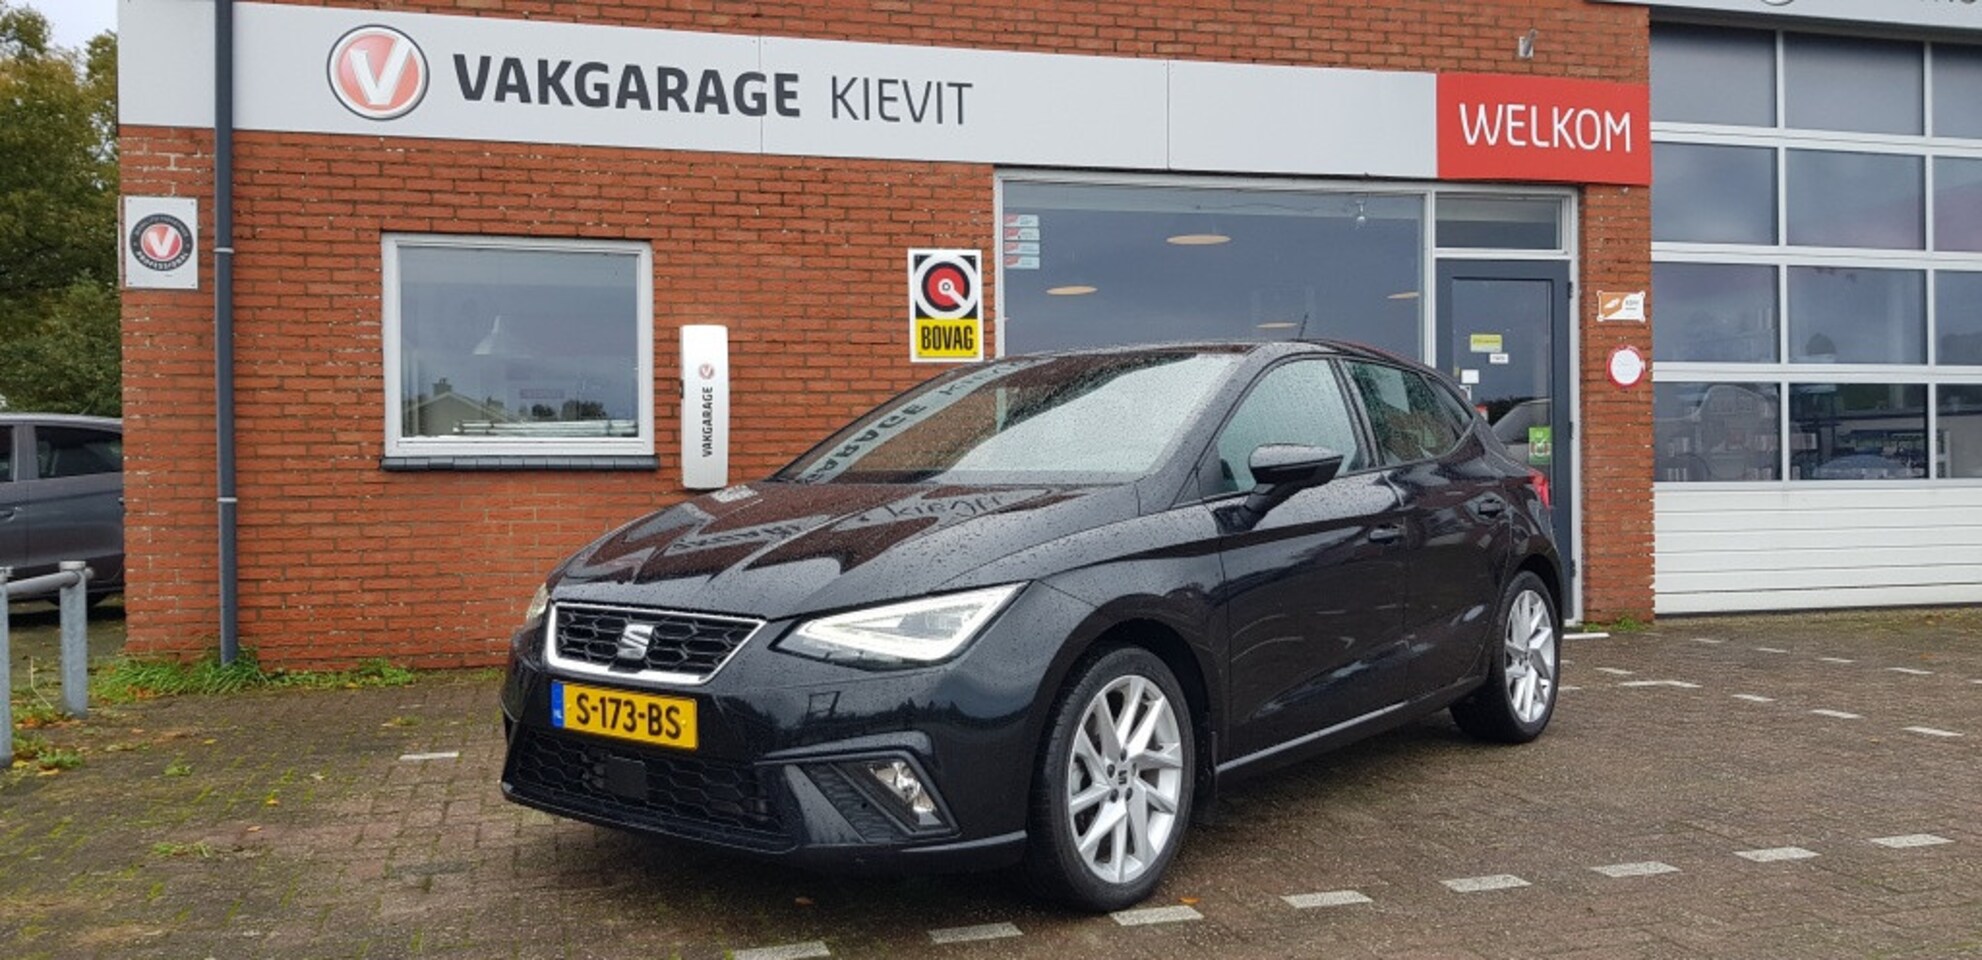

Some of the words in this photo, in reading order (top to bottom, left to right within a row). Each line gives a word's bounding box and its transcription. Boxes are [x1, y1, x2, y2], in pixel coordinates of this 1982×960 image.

[452, 53, 801, 118] VAKGARAGE
[830, 75, 974, 126] KIEVIT
[1459, 102, 1632, 152] WELKOM
[920, 325, 974, 351] BOVAG
[701, 386, 714, 458] VAKGARAGE
[576, 693, 681, 739] S-173-BS
